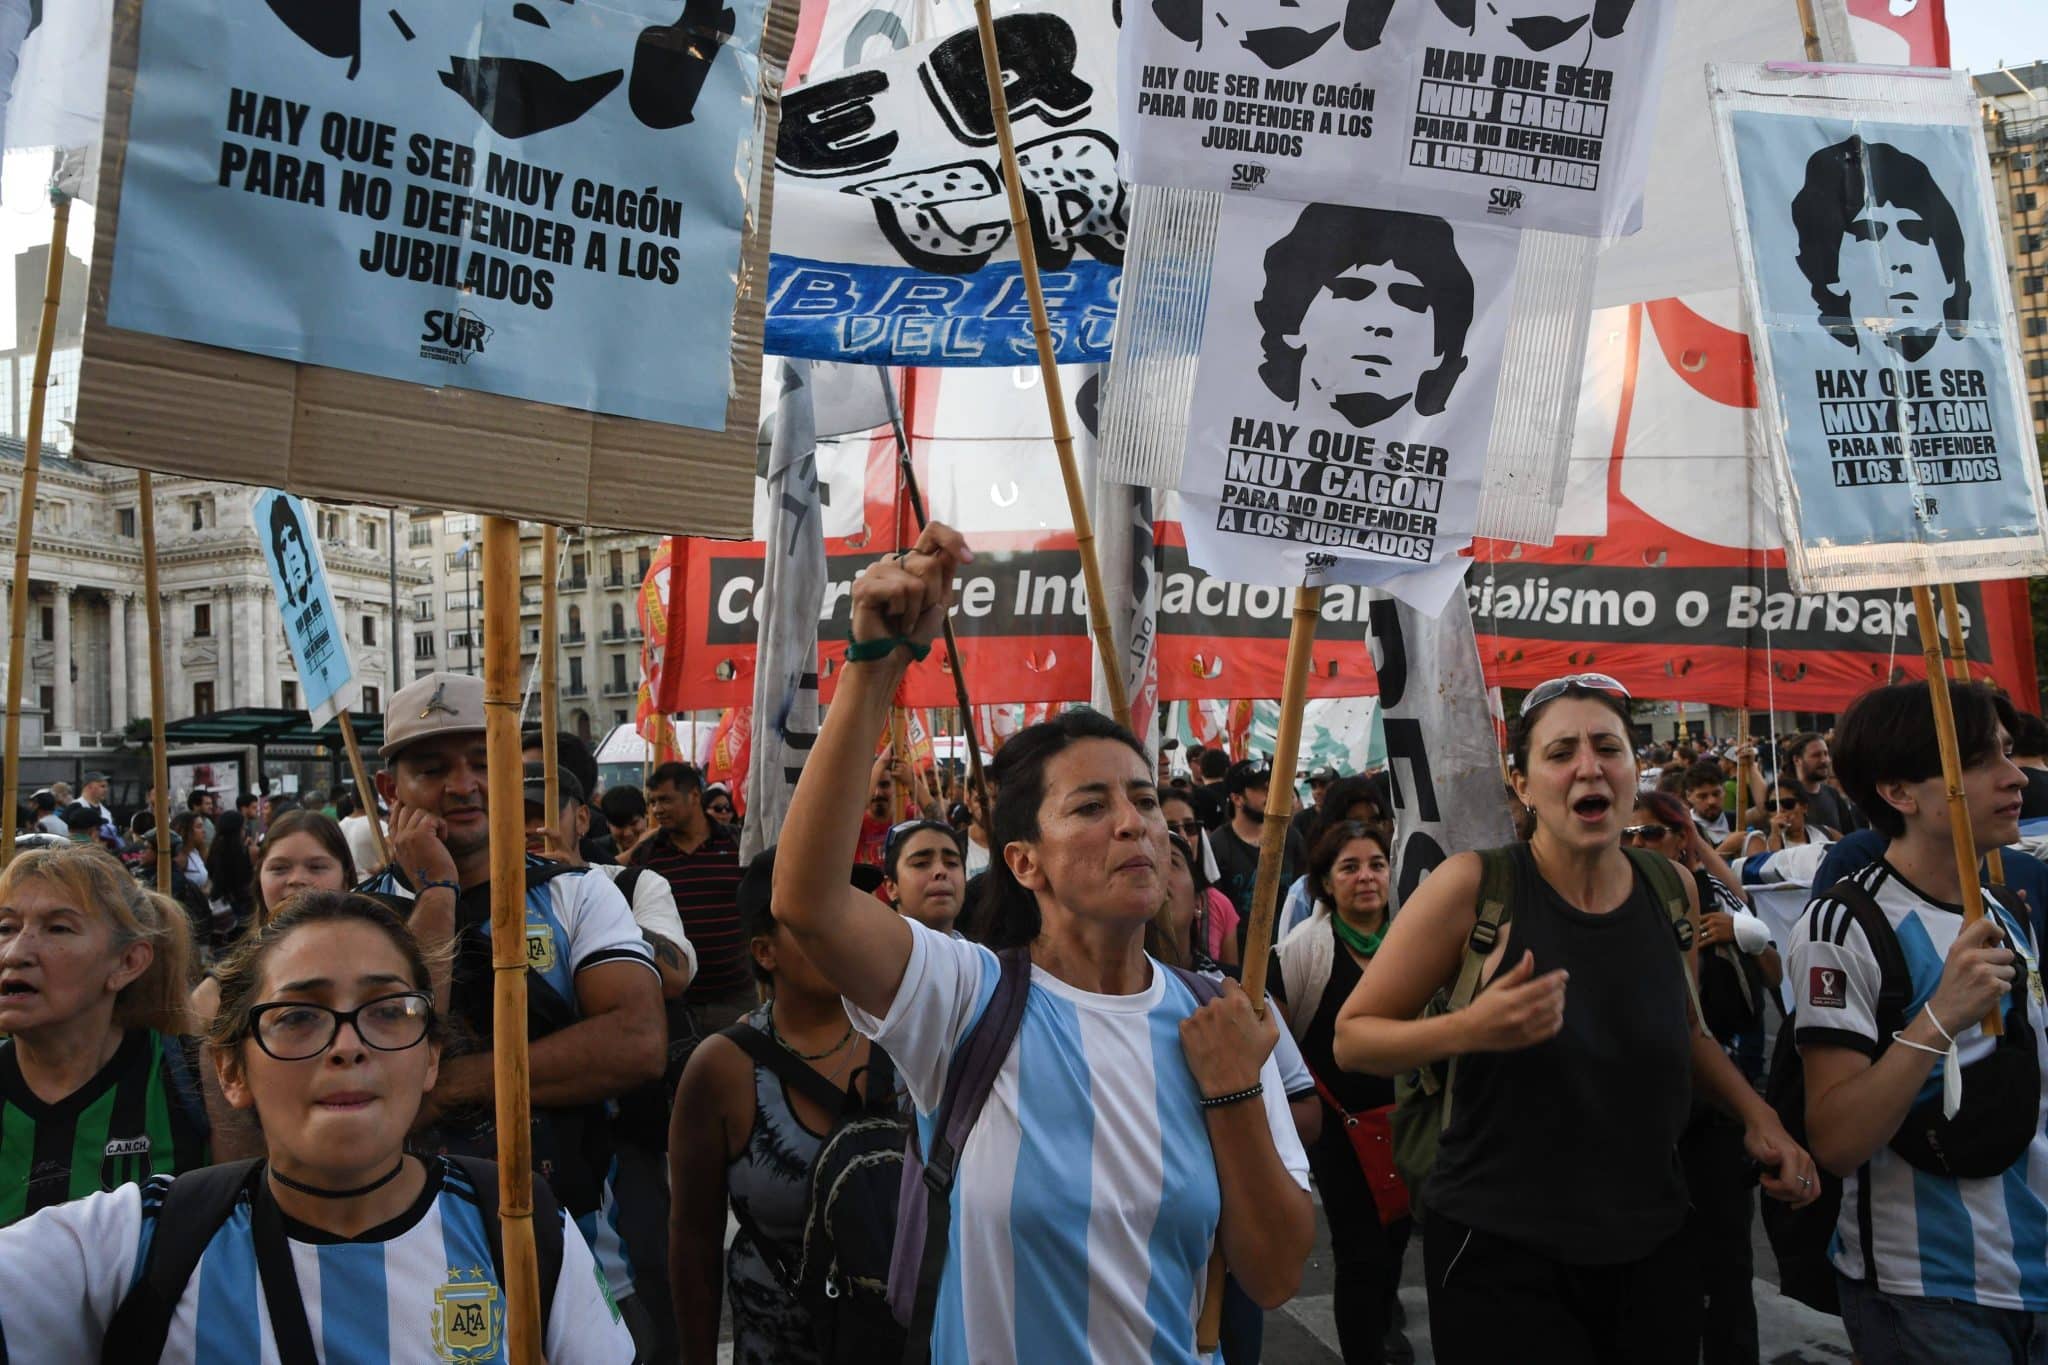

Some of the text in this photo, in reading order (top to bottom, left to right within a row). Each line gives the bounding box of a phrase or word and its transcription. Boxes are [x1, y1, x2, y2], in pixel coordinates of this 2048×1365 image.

[1142, 65, 1375, 112] HAY QUE SER MUY CAGÓN
[1423, 47, 1613, 101] HAY QUE SER
[1138, 92, 1373, 138] PARA NO DEFENDER A LOS
[1418, 82, 1494, 120] MUY
[1202, 126, 1303, 157] JUBILADOS
[1413, 116, 1602, 161] PARA NO DEFENDER
[227, 87, 682, 239] HAY QUE SER MUY CAGÓN
[1231, 163, 1266, 184] SUR
[1411, 142, 1598, 190] A LOS JUBILADOS
[218, 141, 681, 285] PARA NO DEFENDER A LOS
[1488, 188, 1522, 209] SUR
[359, 231, 555, 310] JUBILADOS
[421, 310, 485, 353] SUR
[840, 314, 985, 358] DEL
[1815, 367, 1988, 399] HAY QUE SER
[1821, 402, 1889, 434] MUY
[1230, 416, 1449, 477] HAY QUE SER
[1827, 435, 1998, 458] PARA NO DEFENDER
[1227, 450, 1315, 493] MUY
[1835, 462, 1850, 486] A
[1855, 460, 1892, 484] LOS
[1221, 484, 1437, 536] PARA NO DEFENDER
[1218, 508, 1431, 561] A LOS JUBILADOS
[1675, 590, 1709, 627] o
[451, 1303, 487, 1337] AFA
